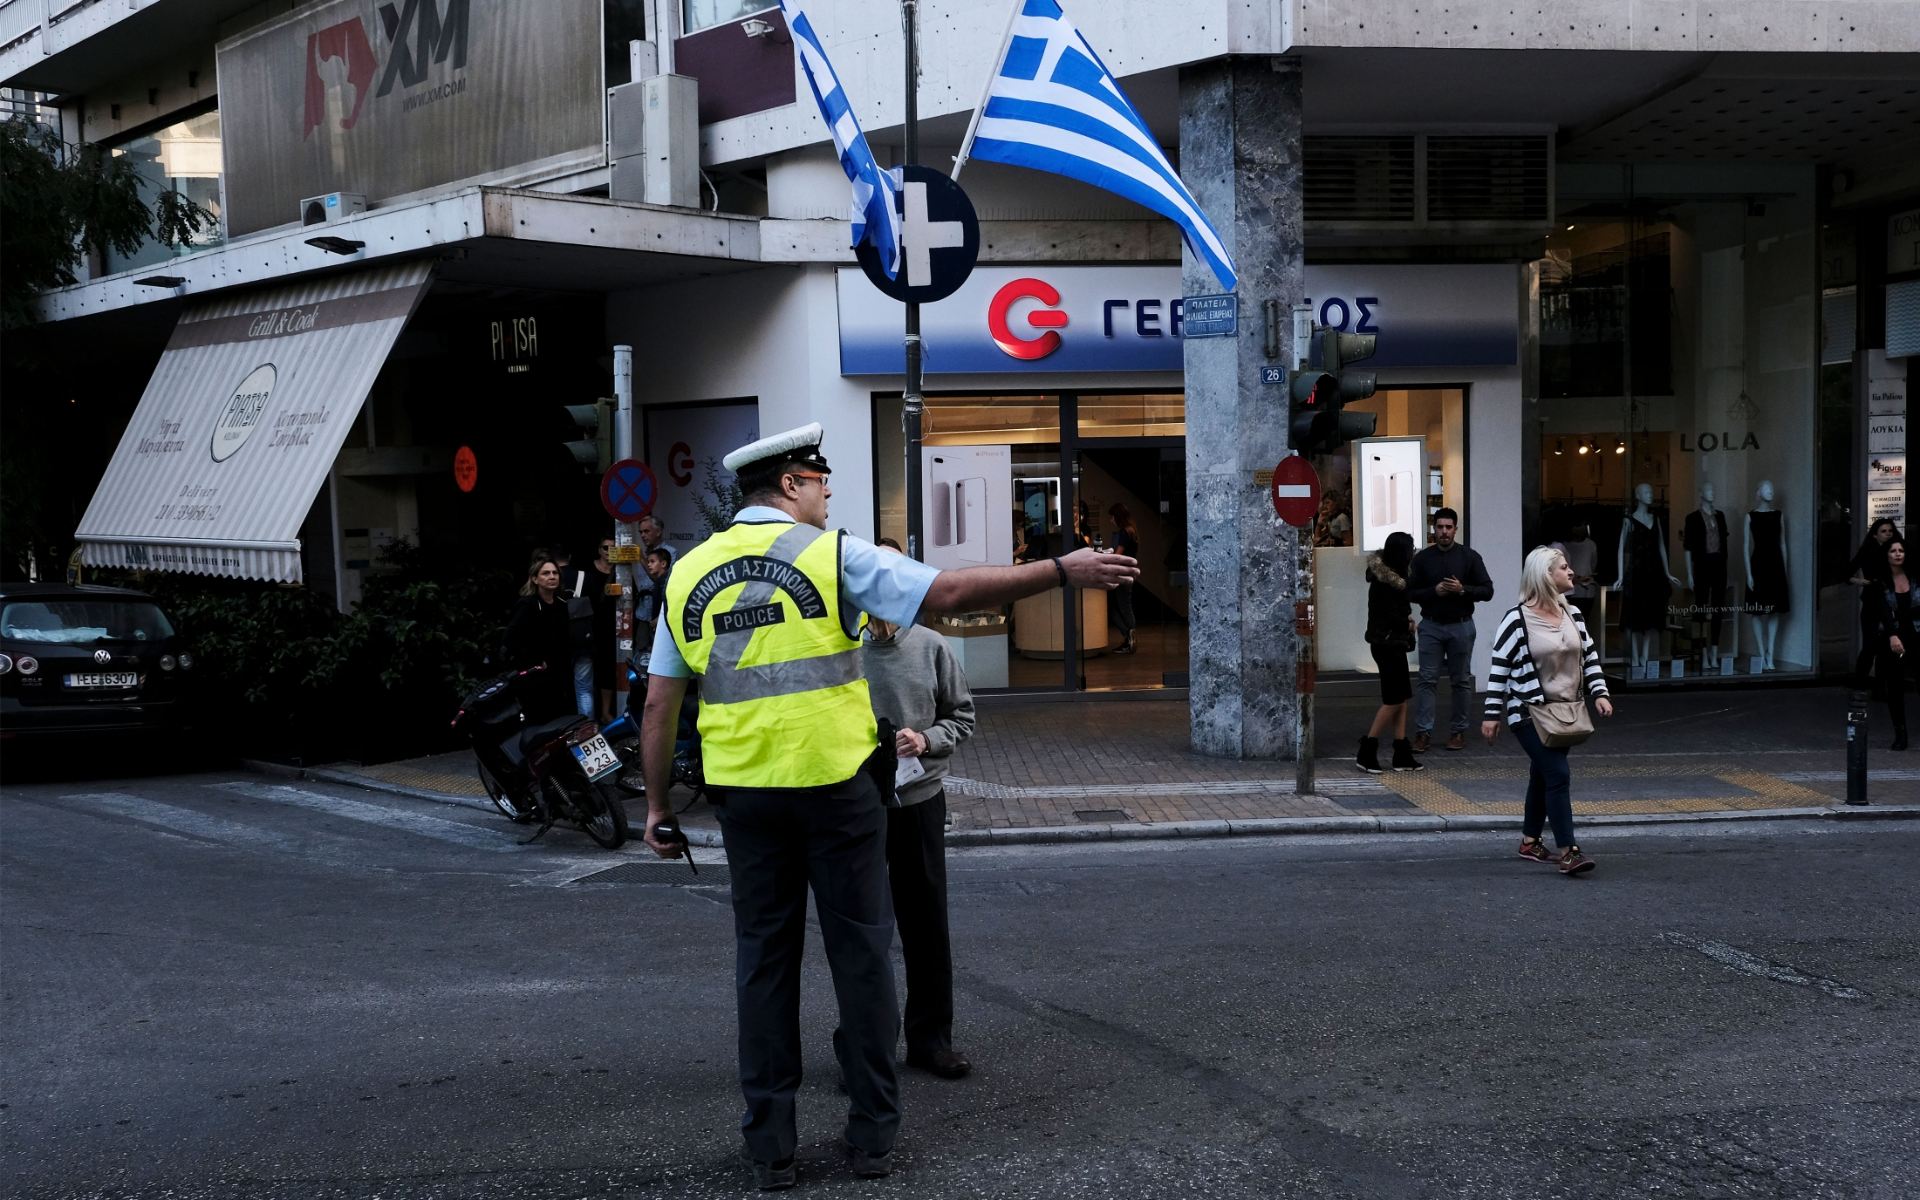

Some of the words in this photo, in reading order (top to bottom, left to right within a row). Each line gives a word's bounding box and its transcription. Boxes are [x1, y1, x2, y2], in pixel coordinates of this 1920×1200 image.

[377, 0, 471, 98] XM
[402, 78, 466, 112] WWW.XM.COM
[1192, 299, 1227, 309] ΠΛΑΤΕΙΑ
[248, 312, 279, 337] Grill
[275, 312, 288, 334] &
[287, 305, 320, 332] Cook
[1267, 369, 1280, 381] 26
[1680, 431, 1760, 452] LOLA
[687, 565, 736, 638] ΕΛΛΗΝΙΚΗ
[742, 559, 820, 617] ΑΣΤΥΝΟΜΙΑ
[1720, 601, 1775, 614] www.lola.gr
[723, 607, 776, 630] POLICE
[105, 673, 134, 685] 6307
[582, 738, 606, 757] BXB
[594, 753, 611, 768] 23
